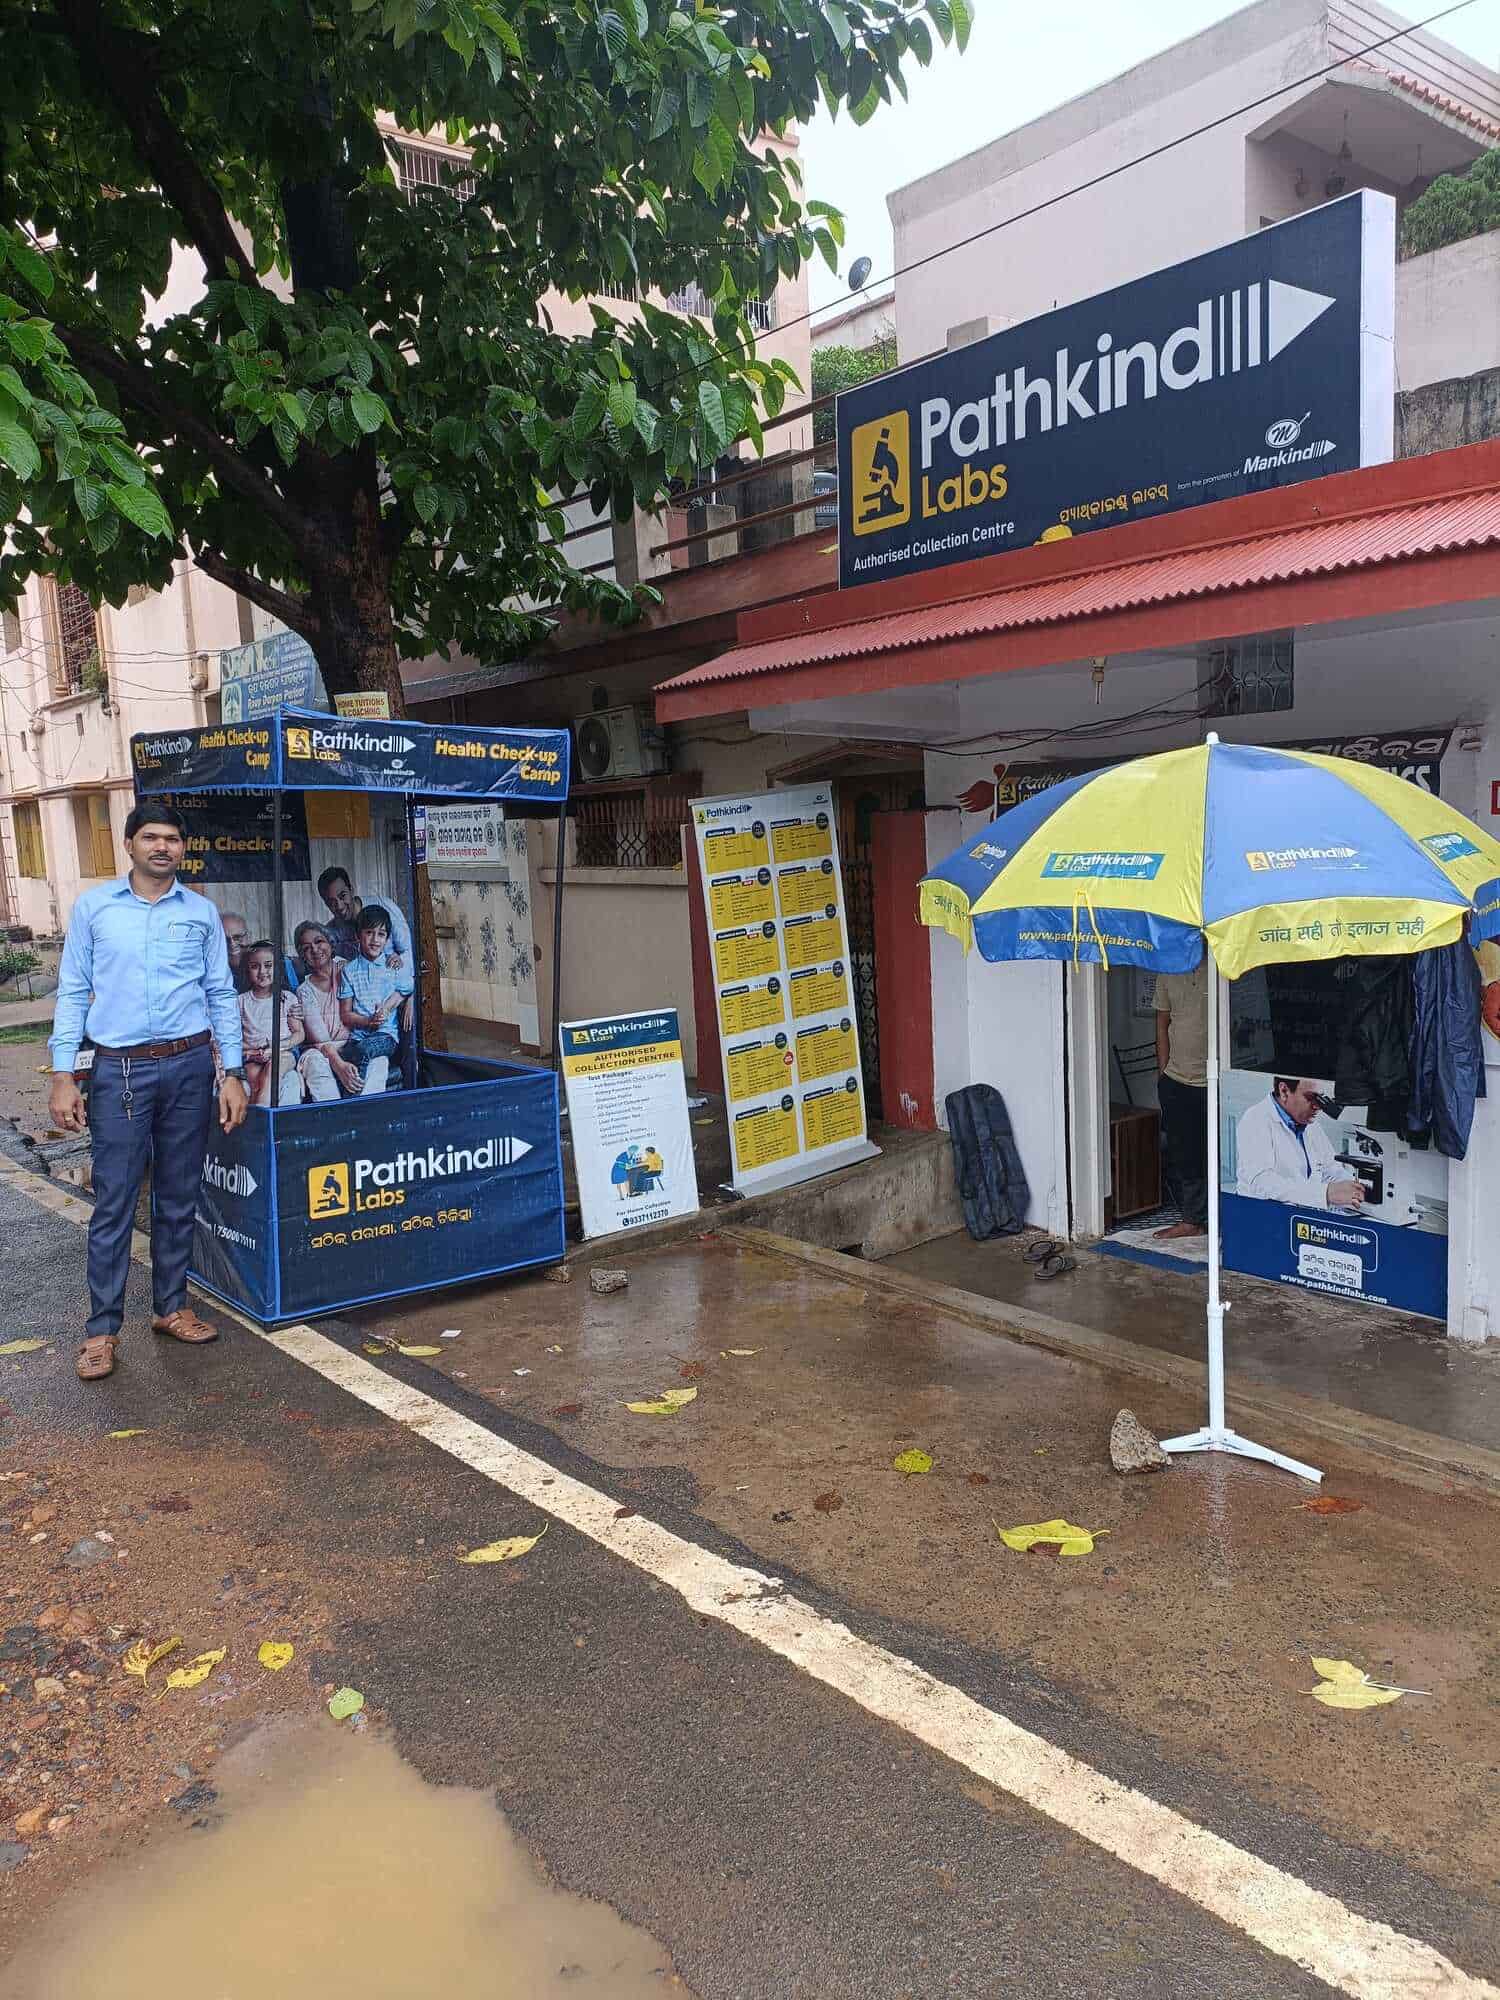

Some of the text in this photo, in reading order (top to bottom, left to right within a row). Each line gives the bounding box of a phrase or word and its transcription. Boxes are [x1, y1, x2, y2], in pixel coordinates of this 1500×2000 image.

[920, 300, 1212, 468] Pathkind
[1243, 442, 1315, 474] Mankind
[921, 462, 1008, 518] Labs
[854, 521, 1015, 572] Authorised Collection Centre
[144, 737, 183, 757] Pathkind
[200, 728, 269, 750] Health Check-up
[312, 730, 393, 753] Pathkind
[245, 750, 271, 770] Camp
[313, 749, 341, 761] Labs
[435, 739, 558, 764] Health Check-up
[520, 765, 561, 784] Camp
[706, 804, 742, 818] Pathkind
[1073, 853, 1136, 867] Pathkind
[1268, 848, 1337, 862] Pathkind
[1258, 916, 1426, 943] जांच सही तो इलाज सही
[590, 1019, 652, 1037] Pathkind
[575, 1051, 676, 1073] COLLECTION CENTRE
[594, 1046, 657, 1062] AUTHORISED
[355, 1139, 493, 1190] Pathkind
[355, 1188, 405, 1212] Labs
[1310, 1225, 1357, 1245] Pathkind
[1280, 1273, 1388, 1304] www.pathkindlabs.com
